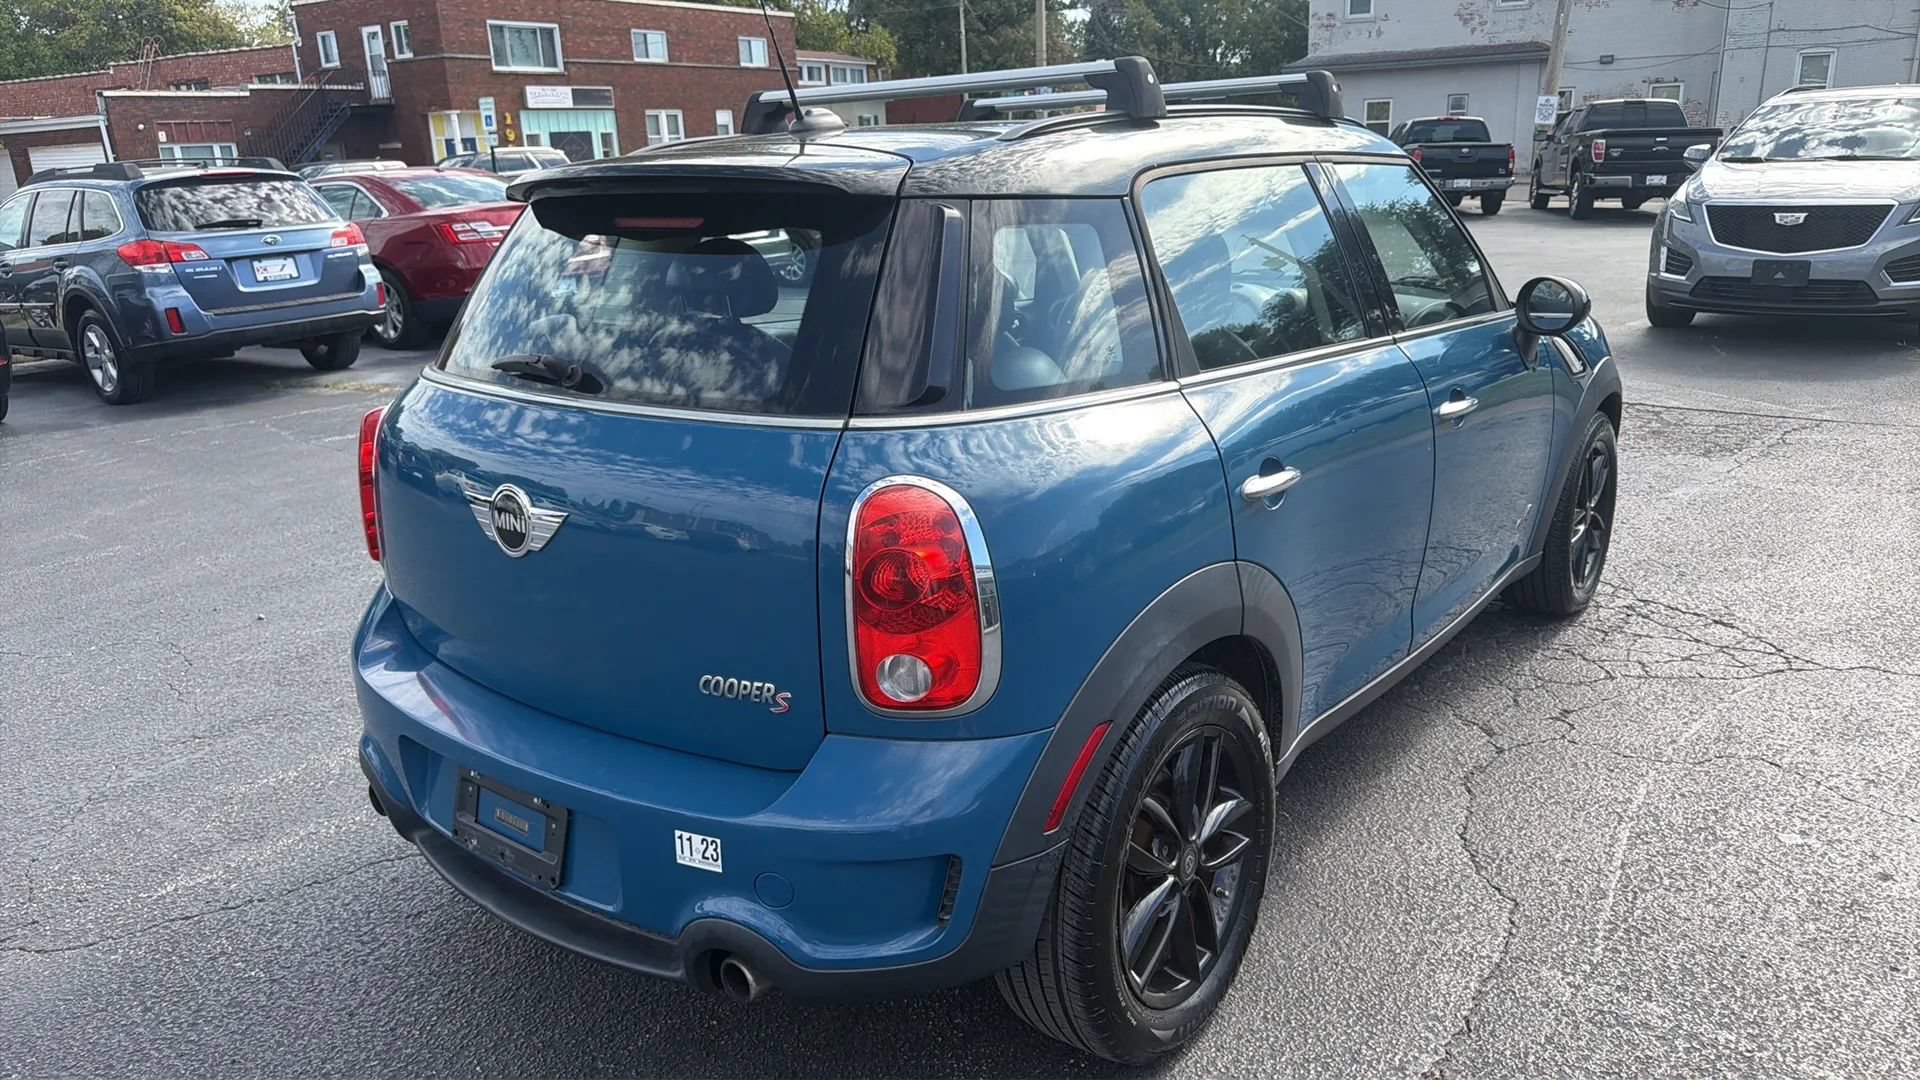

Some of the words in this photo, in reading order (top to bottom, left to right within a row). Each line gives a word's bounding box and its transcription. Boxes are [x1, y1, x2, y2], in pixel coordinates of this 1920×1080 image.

[494, 509, 526, 534] MINI
[699, 674, 776, 705] COOPER
[768, 692, 792, 713] S
[677, 833, 693, 857] 11
[701, 837, 719, 862] 23
